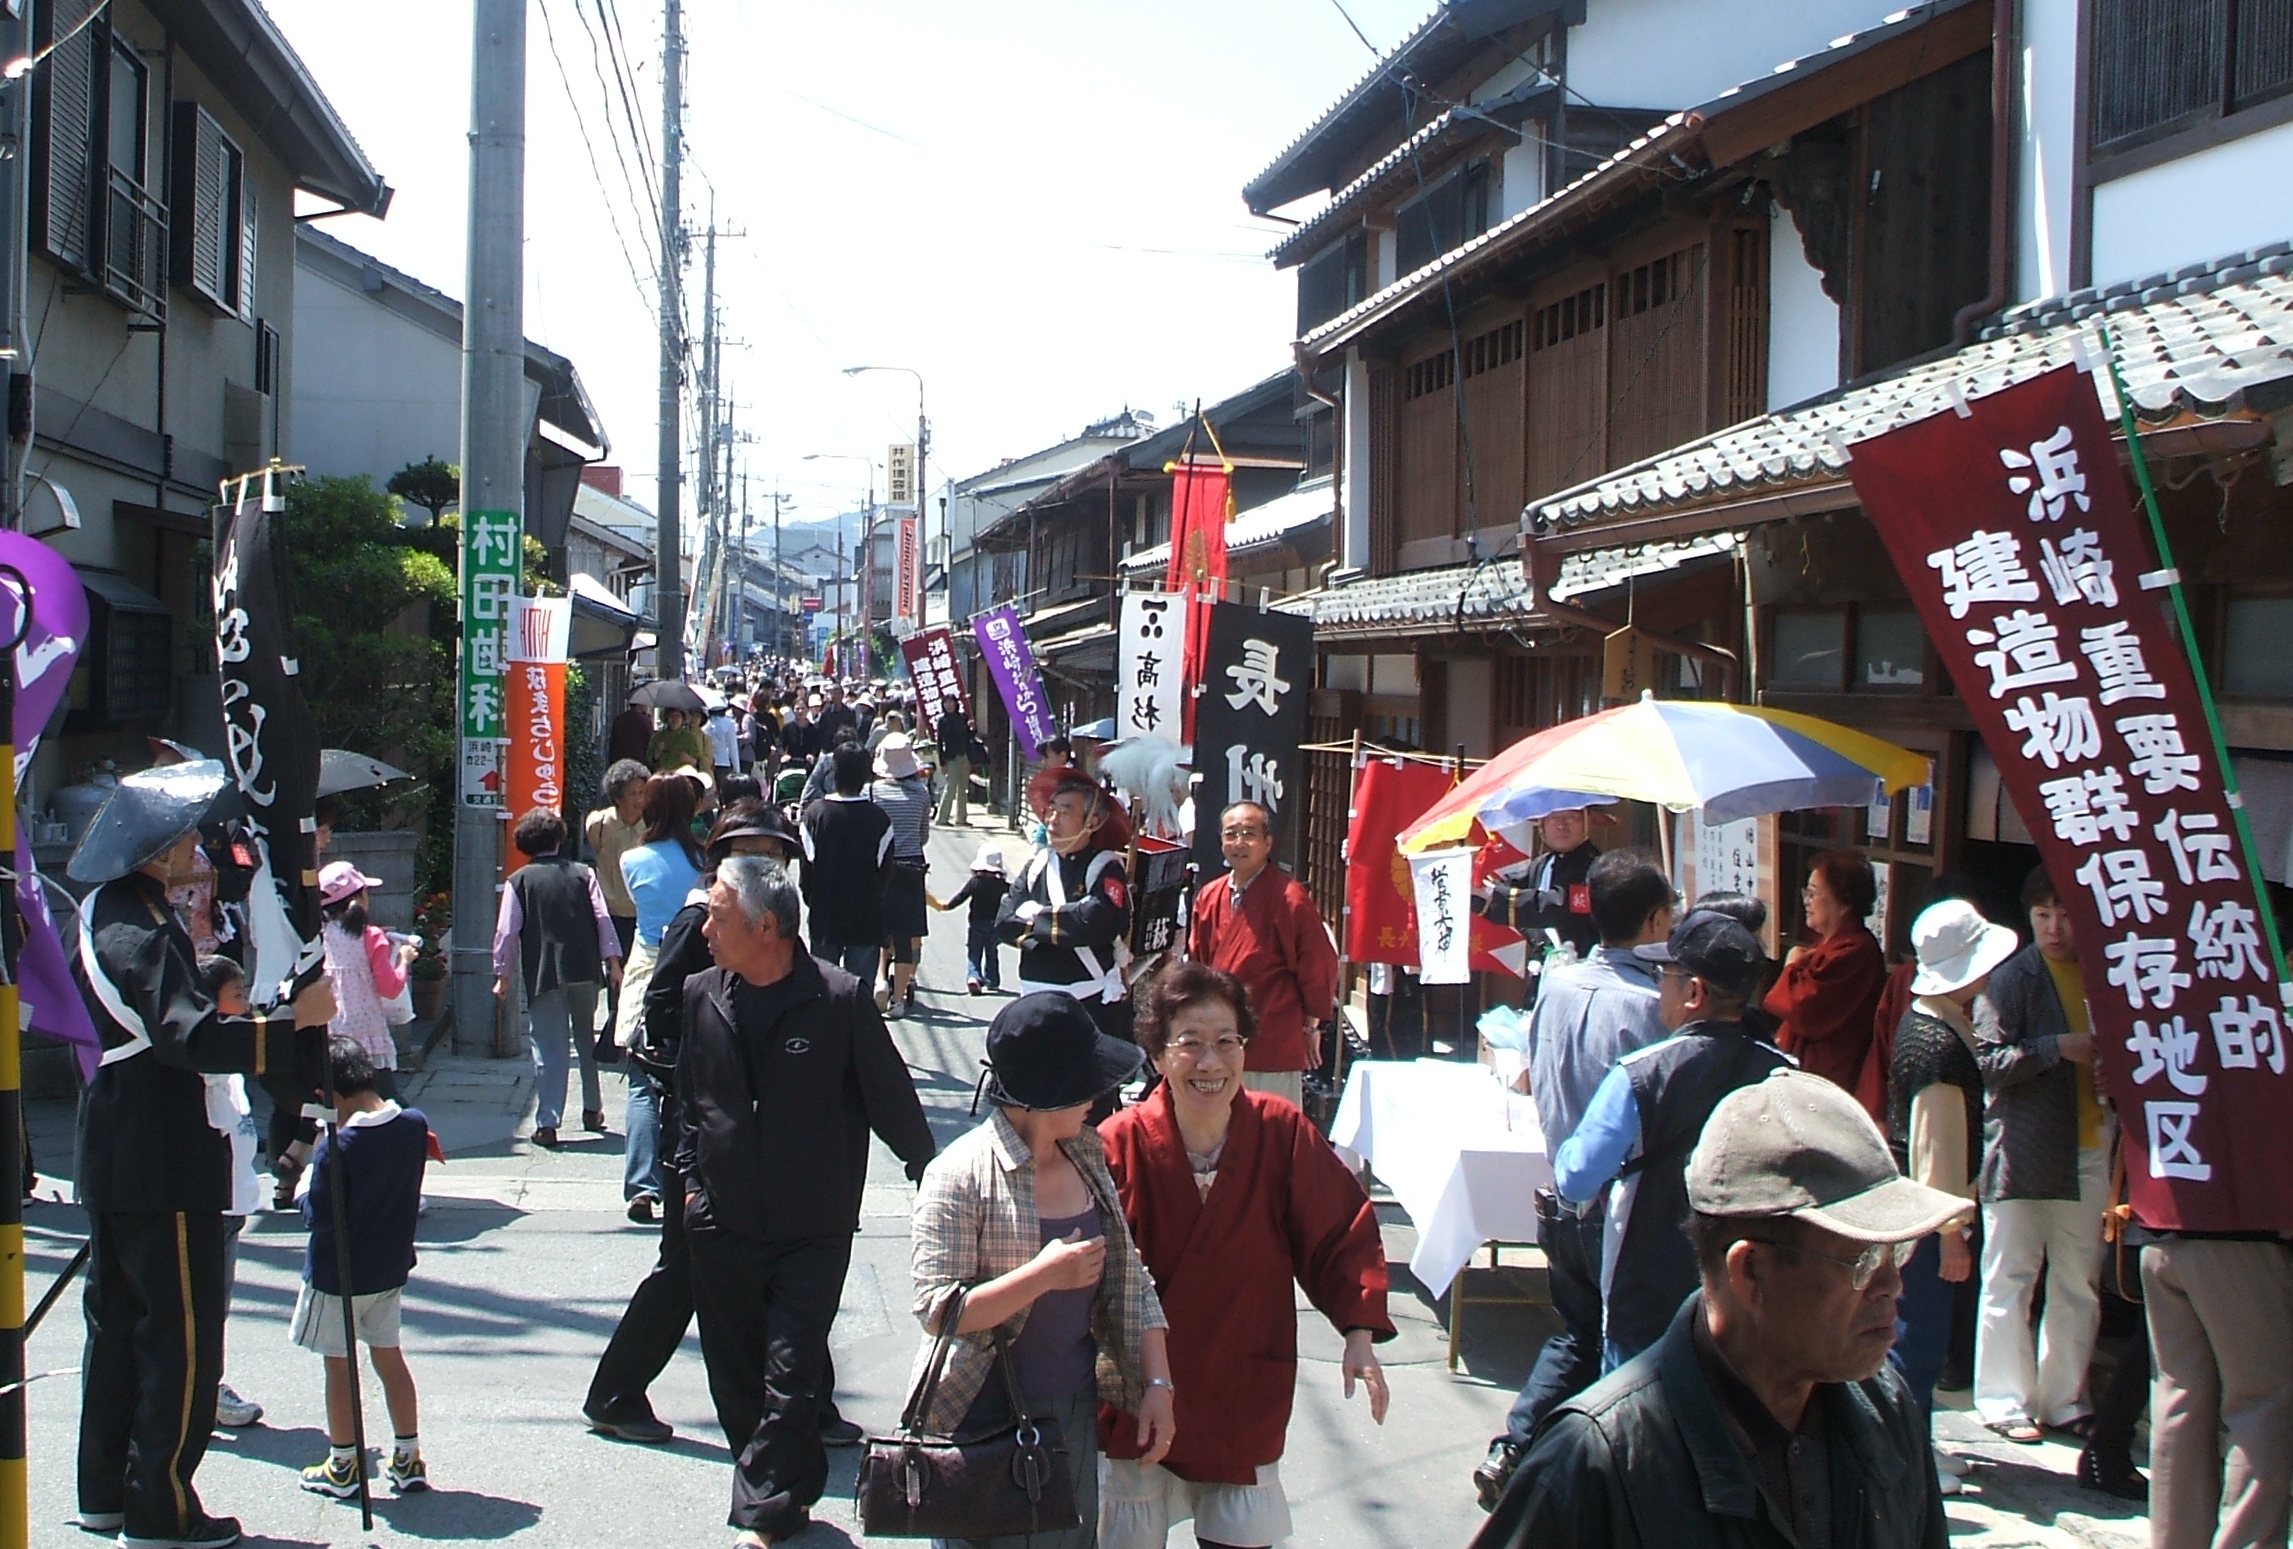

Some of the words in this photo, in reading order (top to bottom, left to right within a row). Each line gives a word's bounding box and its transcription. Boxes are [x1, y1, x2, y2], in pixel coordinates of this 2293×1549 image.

[469, 741, 497, 753] 浜崎
[1927, 529, 2211, 1181] 建造物群保存地区
[2001, 426, 2286, 1075] 浜崎重要伝統的
